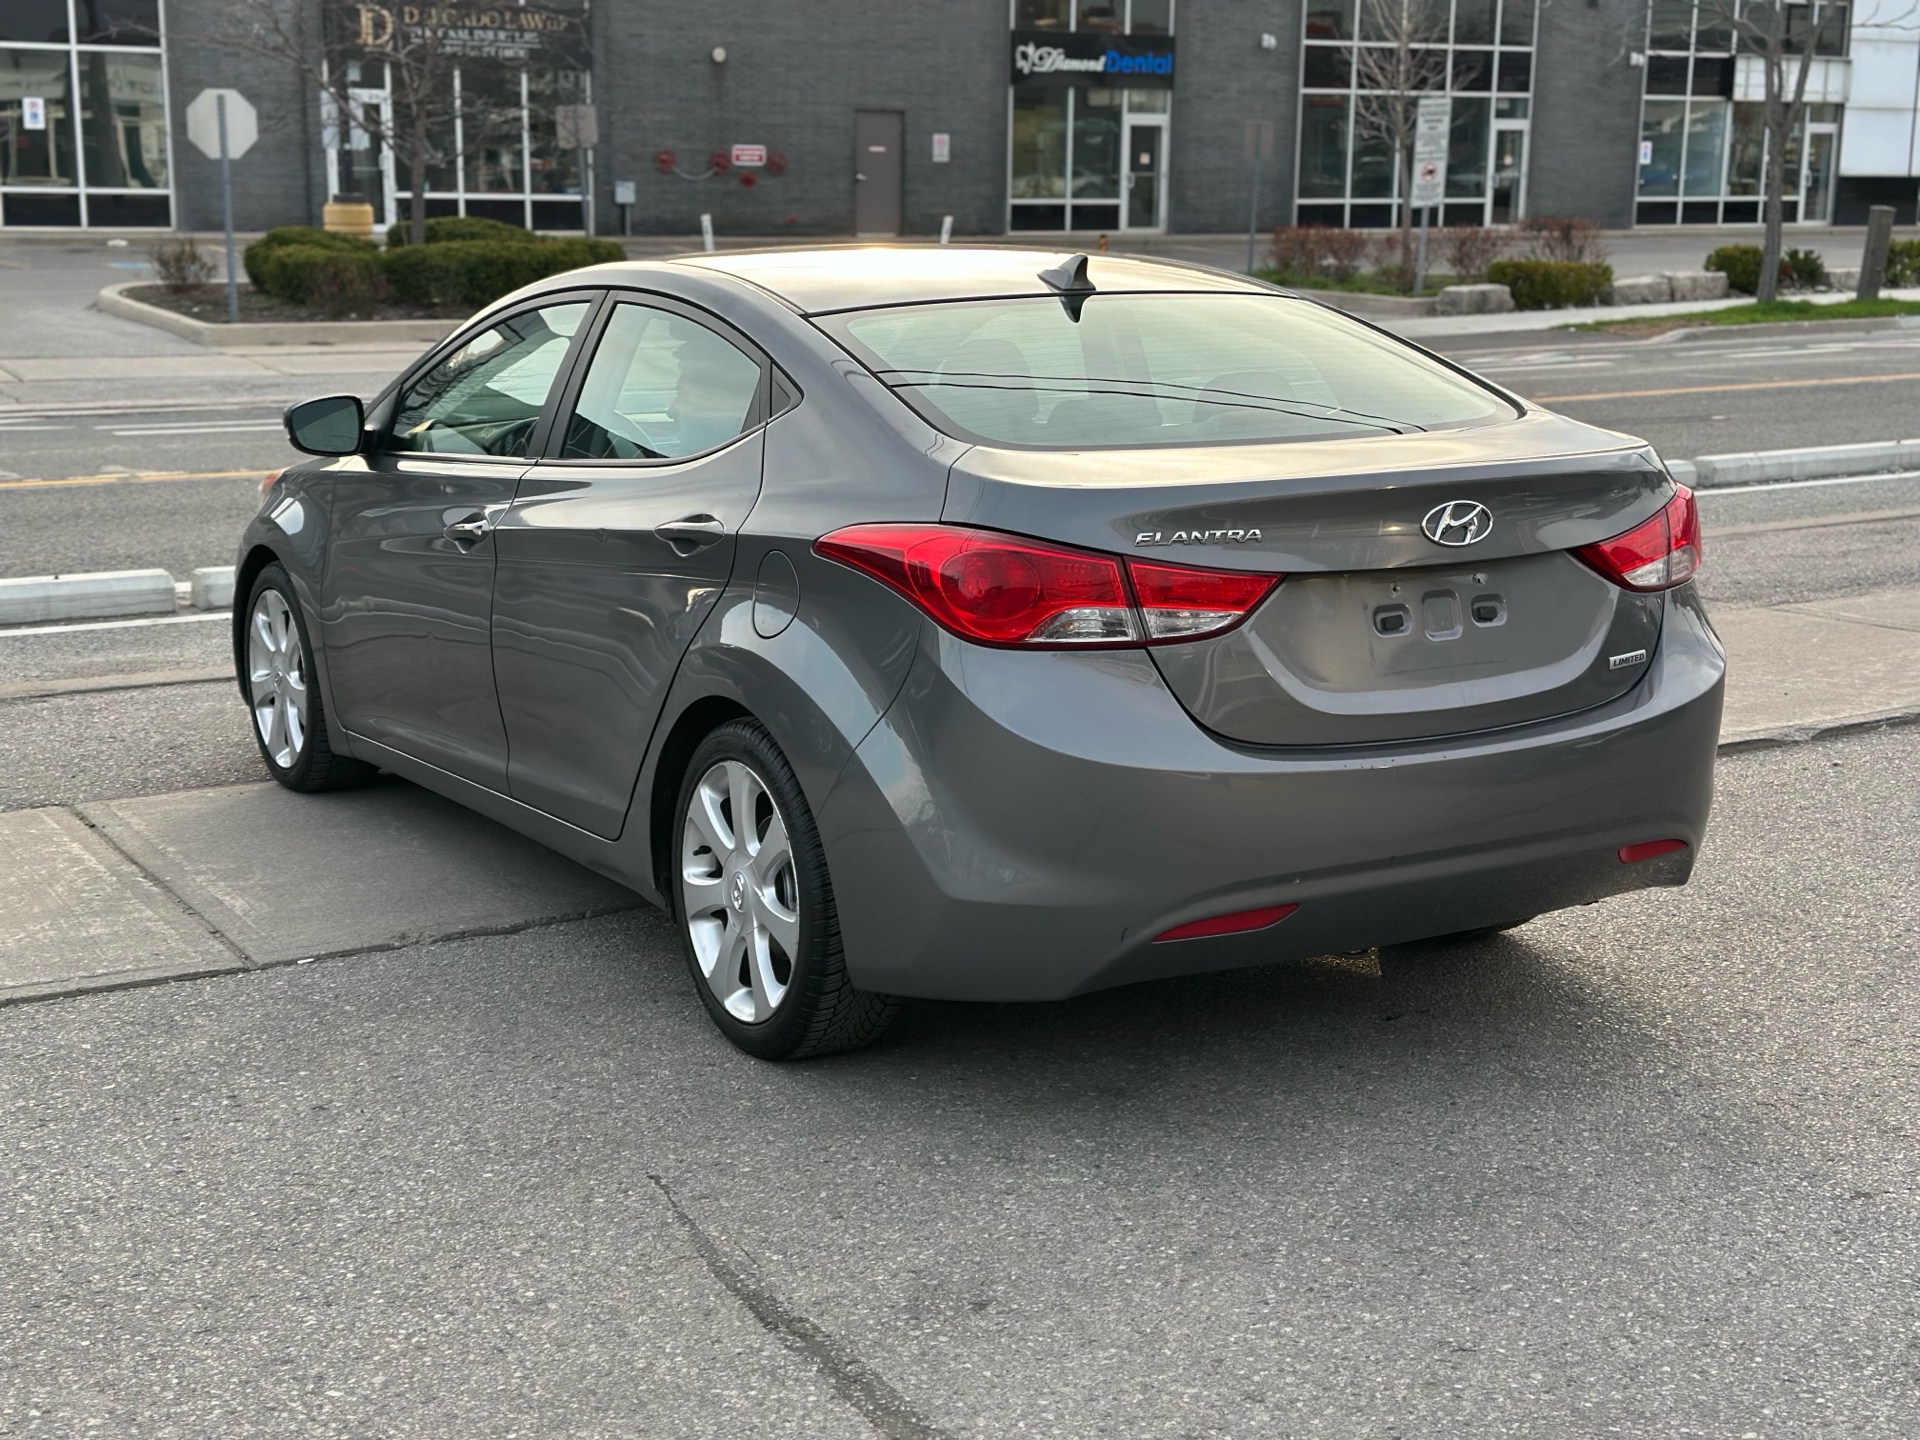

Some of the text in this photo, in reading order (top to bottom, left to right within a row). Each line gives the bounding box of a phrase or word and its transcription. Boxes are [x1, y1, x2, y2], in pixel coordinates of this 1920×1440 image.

[1105, 50, 1173, 74] Dental
[1134, 528, 1262, 547] ELANTRA
[1613, 652, 1645, 667] LIMITED
